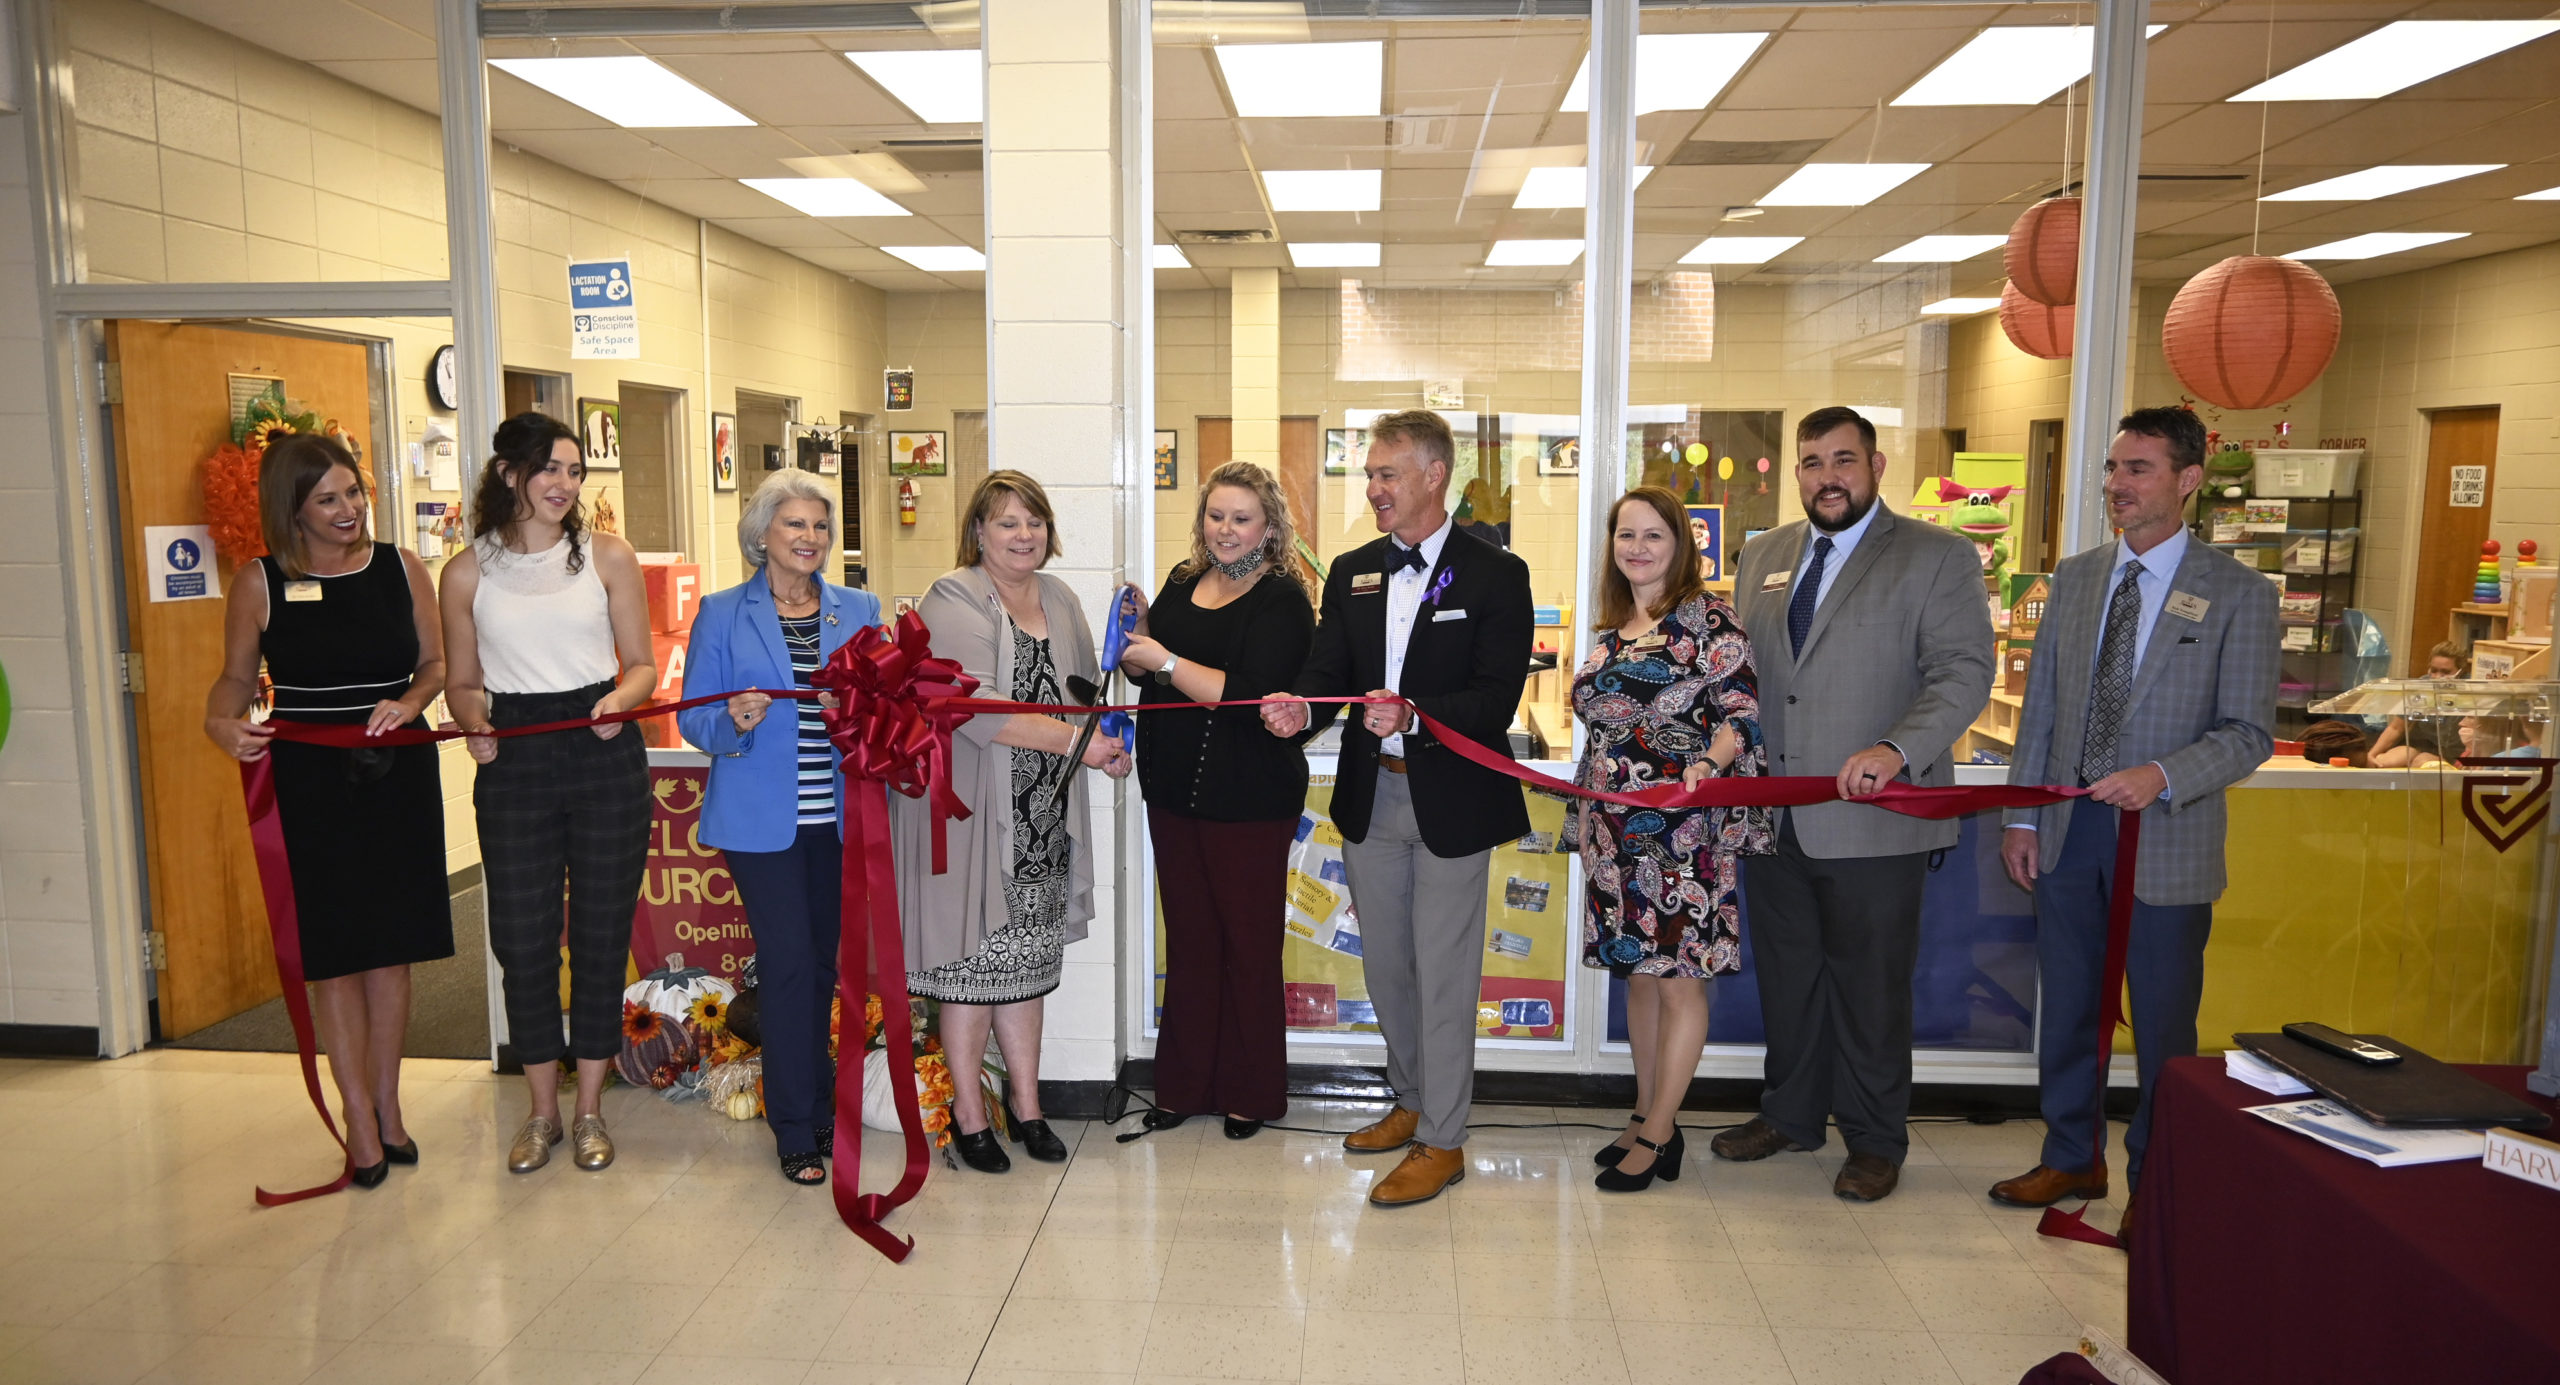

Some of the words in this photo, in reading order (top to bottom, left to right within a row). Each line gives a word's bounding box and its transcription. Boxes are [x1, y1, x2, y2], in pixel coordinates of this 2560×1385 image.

[571, 275, 607, 286] LACTATION
[580, 286, 600, 296] ROOM
[592, 314, 634, 322] Conscious
[592, 321, 634, 331] Discipline
[580, 336, 602, 345] Safe
[604, 335, 634, 346] Space
[592, 346, 617, 355] Area
[2455, 468, 2464, 480] NO
[2466, 468, 2482, 480] FOOD
[2452, 480, 2460, 491] OR
[2462, 480, 2483, 492] DRINKS
[2453, 492, 2480, 504] ALLOWED
[676, 575, 695, 621] F
[661, 645, 685, 690] A
[637, 868, 743, 905] URC
[1299, 875, 1326, 897] Sensory
[1325, 895, 1333, 904] &
[1296, 886, 1317, 904] tactile
[1285, 920, 1313, 938] Puzzles
